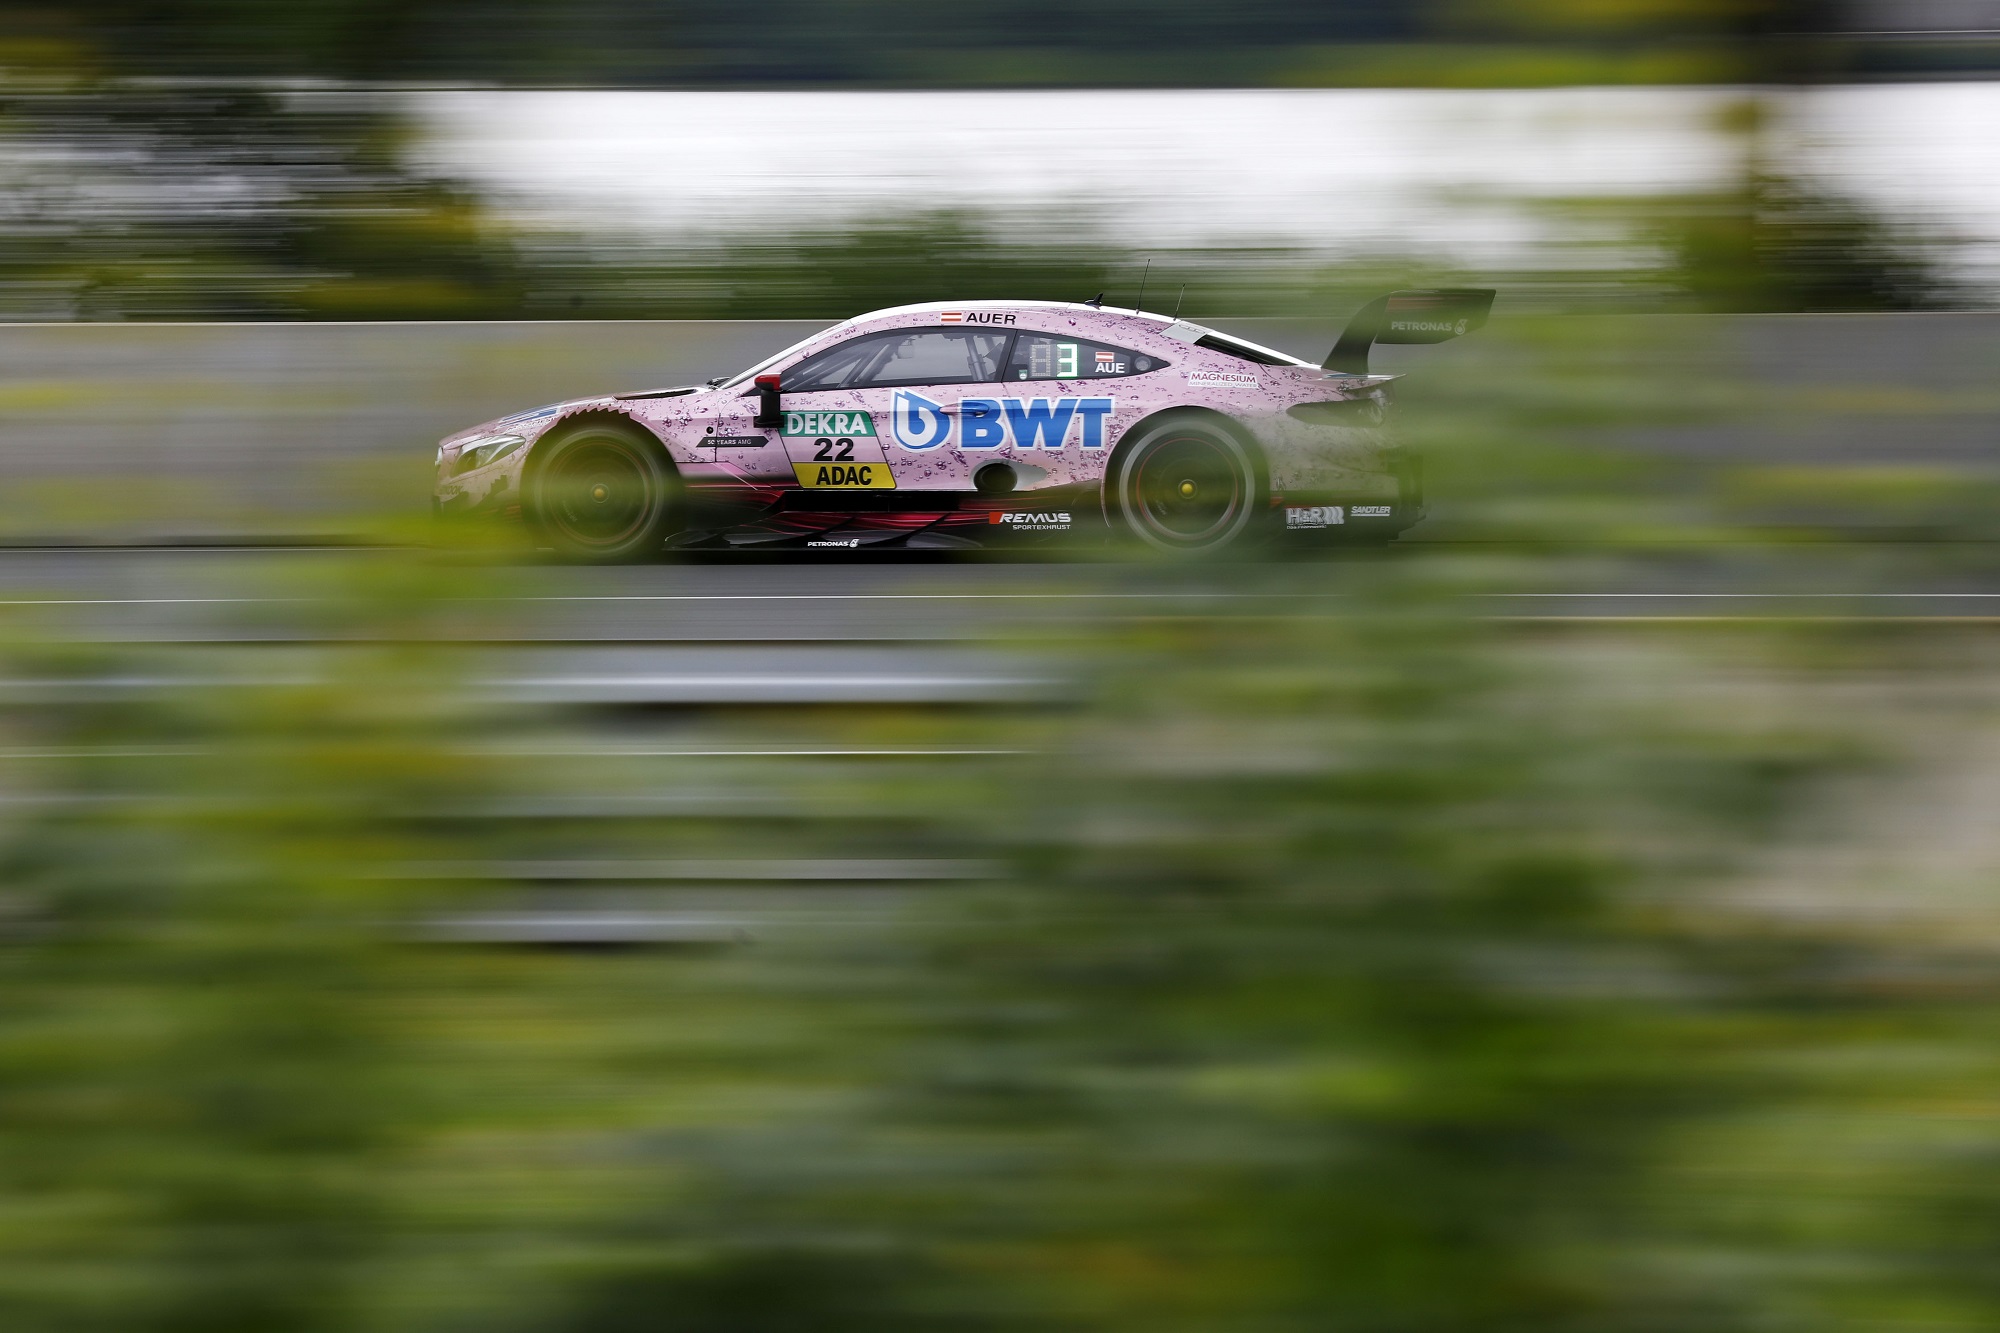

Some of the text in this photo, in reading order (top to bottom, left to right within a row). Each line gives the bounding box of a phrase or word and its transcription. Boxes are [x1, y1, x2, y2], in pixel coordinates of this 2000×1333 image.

[966, 312, 1017, 325] AUER
[1391, 321, 1452, 332] PETRONAS
[1095, 362, 1125, 374] AUE
[1191, 372, 1256, 383] MAGNESIUM
[786, 413, 867, 435] DEKRA
[959, 398, 1113, 449] BWT
[813, 437, 855, 462] 22
[816, 466, 872, 486] ADAC
[1351, 505, 1392, 514] SANDTLER
[999, 513, 1072, 524] REMUS
